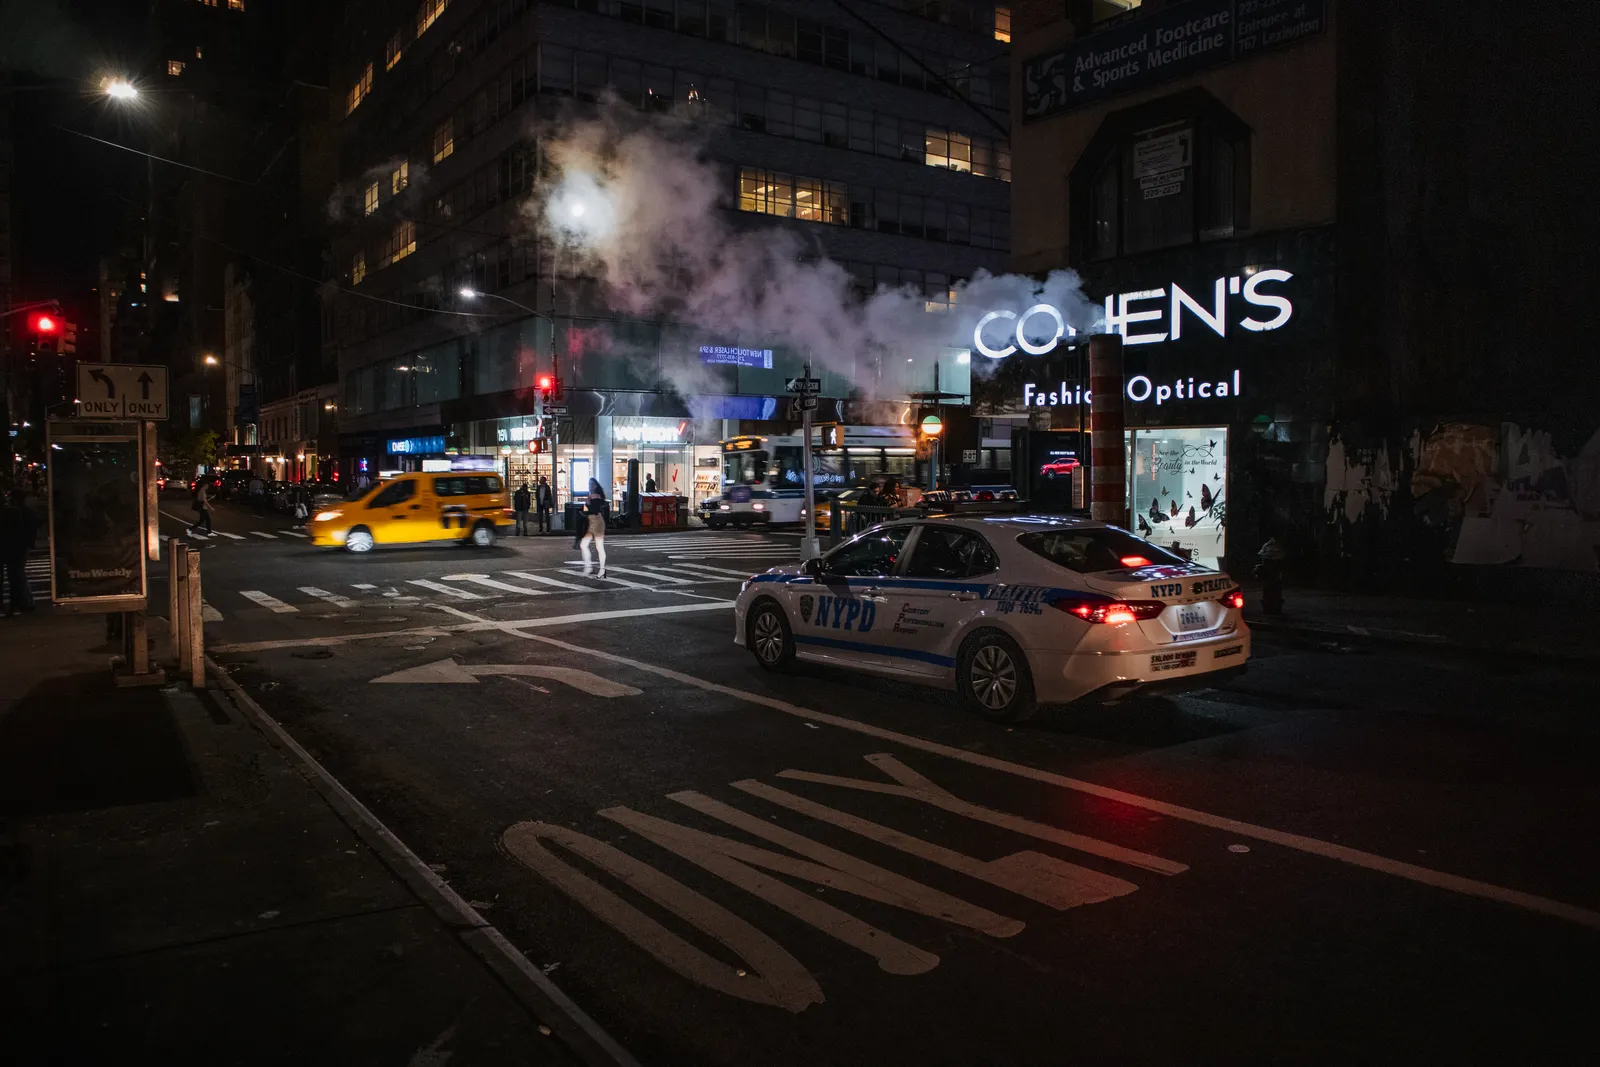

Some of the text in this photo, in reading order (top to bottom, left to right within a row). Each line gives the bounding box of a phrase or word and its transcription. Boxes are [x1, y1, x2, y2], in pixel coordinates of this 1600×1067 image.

[1238, 3, 1306, 36] Entrance at
[1238, 18, 1319, 53] 767 Lexington
[1073, 9, 1229, 74] Advanced Footcare
[1073, 31, 1224, 93] & Sports Medicine
[1145, 184, 1181, 198] 223-2277
[1127, 369, 1241, 406] Optical
[84, 401, 162, 415] ONLY ONLY
[1144, 456, 1187, 476] Beauty
[68, 567, 132, 580] The Weekly
[983, 584, 1052, 602] TRAFFIC
[1151, 583, 1182, 598] NYPD
[814, 595, 876, 633] NYPD
[501, 752, 1190, 1015] ONLY
